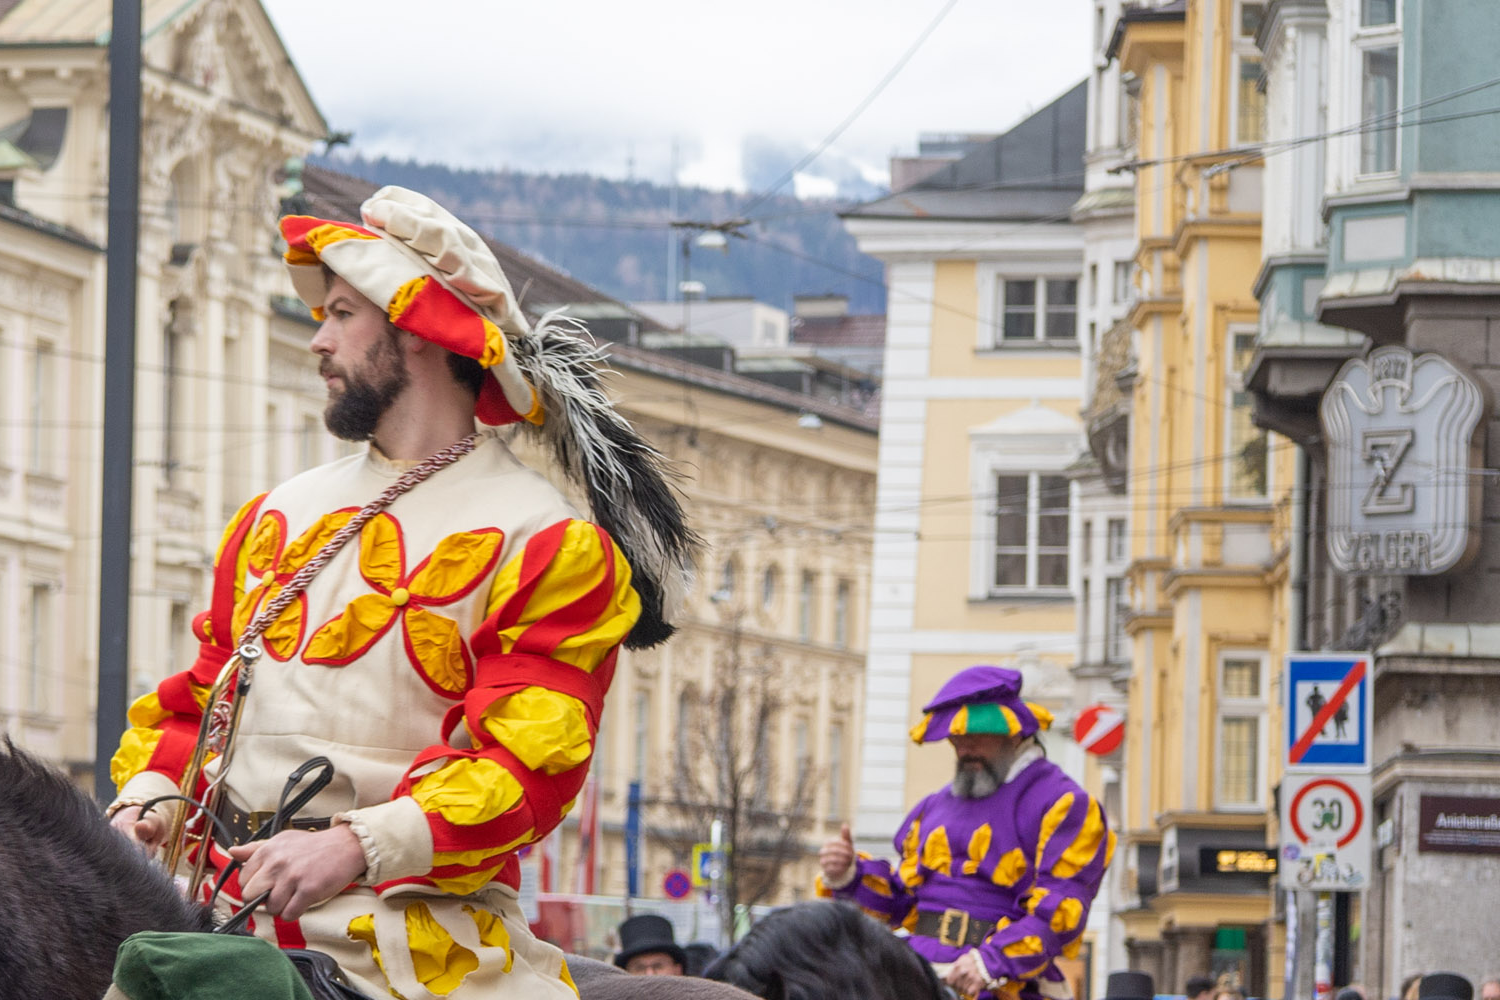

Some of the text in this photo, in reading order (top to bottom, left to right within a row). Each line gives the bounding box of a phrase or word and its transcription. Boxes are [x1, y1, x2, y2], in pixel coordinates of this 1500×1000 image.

[1362, 429, 1415, 515] Z
[1348, 530, 1431, 569] ZELGER
[1311, 798, 1343, 832] 30
